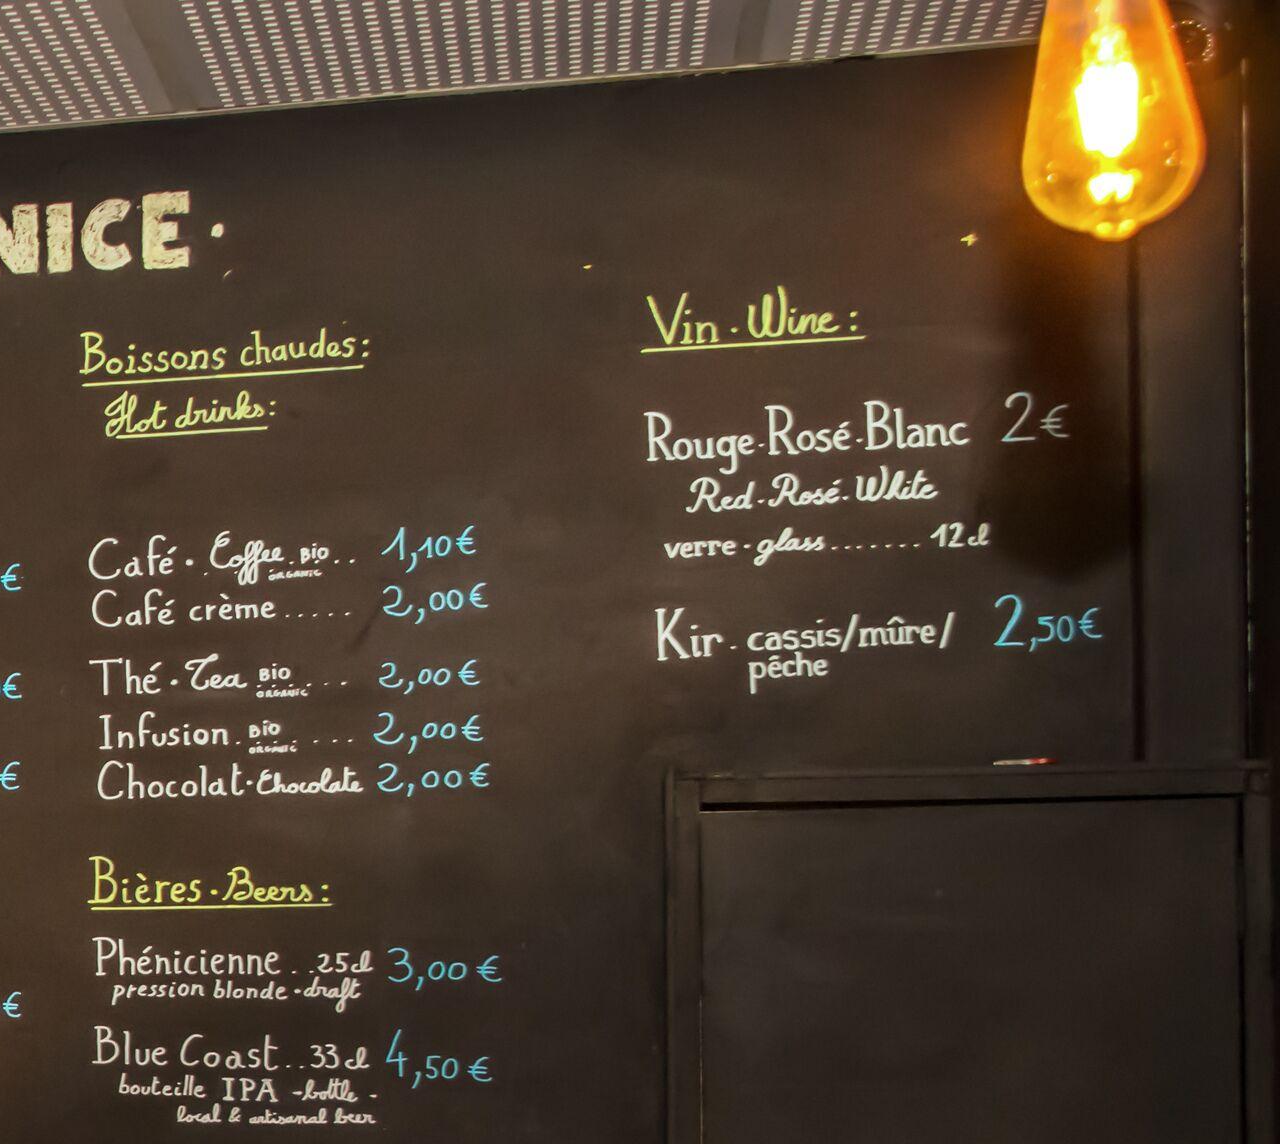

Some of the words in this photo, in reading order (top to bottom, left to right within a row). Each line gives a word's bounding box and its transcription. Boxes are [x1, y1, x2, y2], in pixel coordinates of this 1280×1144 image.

[647, 292, 718, 344] Vin
[79, 332, 227, 375] Boissons
[240, 328, 370, 366] chaudes:
[104, 391, 167, 438] Hot
[1001, 391, 1070, 442] 2€
[88, 535, 178, 580] Café
[209, 531, 285, 585] Coffee
[664, 539, 737, 559] verre
[754, 528, 825, 566] glass
[91, 588, 176, 628] Café
[188, 594, 276, 621] crème
[655, 608, 724, 661] Kir
[993, 594, 1103, 652] 2,50€
[89, 657, 161, 697] Thé
[185, 654, 248, 690] Tea
[748, 651, 828, 694] pêche
[99, 711, 228, 751] Infusion
[87, 855, 201, 904] Bières
[92, 936, 280, 977] Phénicienne
[111, 980, 205, 1006] pression
[213, 977, 289, 1000] blonde
[91, 1026, 168, 1066] Blue
[179, 1034, 280, 1071] Coast
[118, 1073, 207, 1098] bouteille
[221, 1077, 279, 1102] IPA
[176, 1104, 221, 1124] local
[228, 1106, 241, 1123] &
[249, 1108, 327, 1124] artisanal
[333, 1107, 376, 1125] beer
